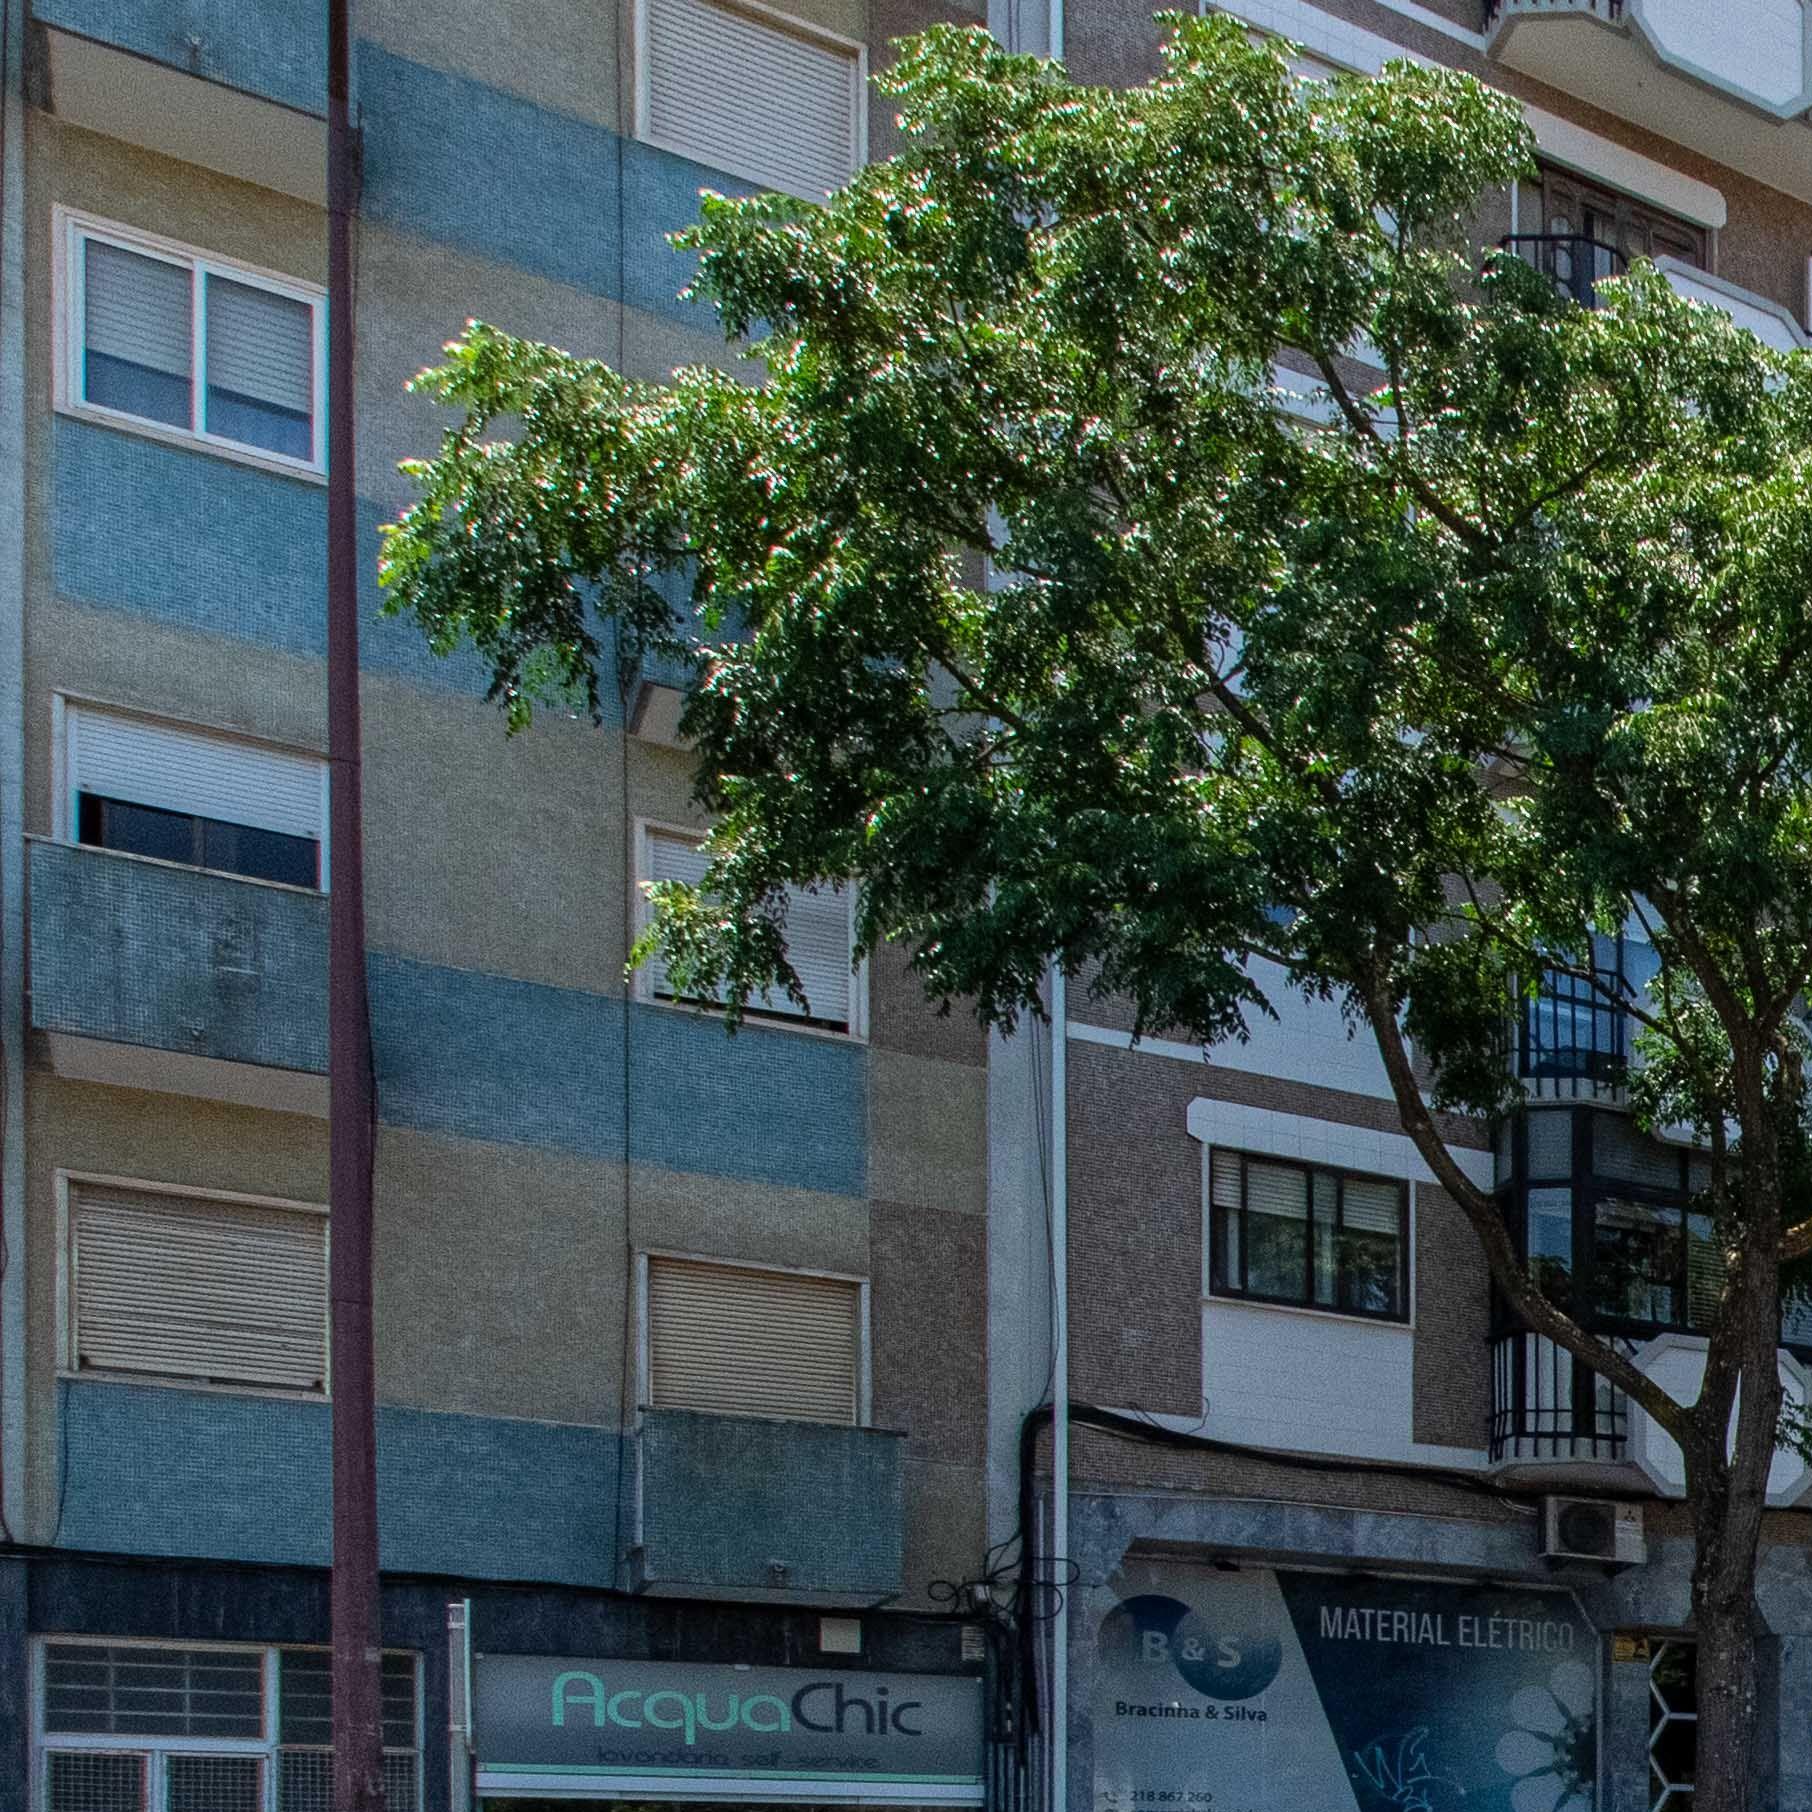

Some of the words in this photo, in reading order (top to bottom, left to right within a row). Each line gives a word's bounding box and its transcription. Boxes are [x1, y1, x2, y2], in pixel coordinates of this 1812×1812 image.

[1319, 1606, 1451, 1646] MATERIAL
[1457, 1610, 1574, 1653] ELÉTRICO
[1141, 1630, 1170, 1663] B
[1181, 1637, 1206, 1661] &
[1216, 1635, 1242, 1668] S
[552, 1671, 922, 1745] AcquaChic
[1115, 1701, 1200, 1719] Bracinha
[1205, 1704, 1219, 1720] &
[1224, 1704, 1268, 1722] Silva
[1130, 1791, 1155, 1803] 218
[1158, 1791, 1184, 1803] 867
[1186, 1792, 1213, 1803] 260
